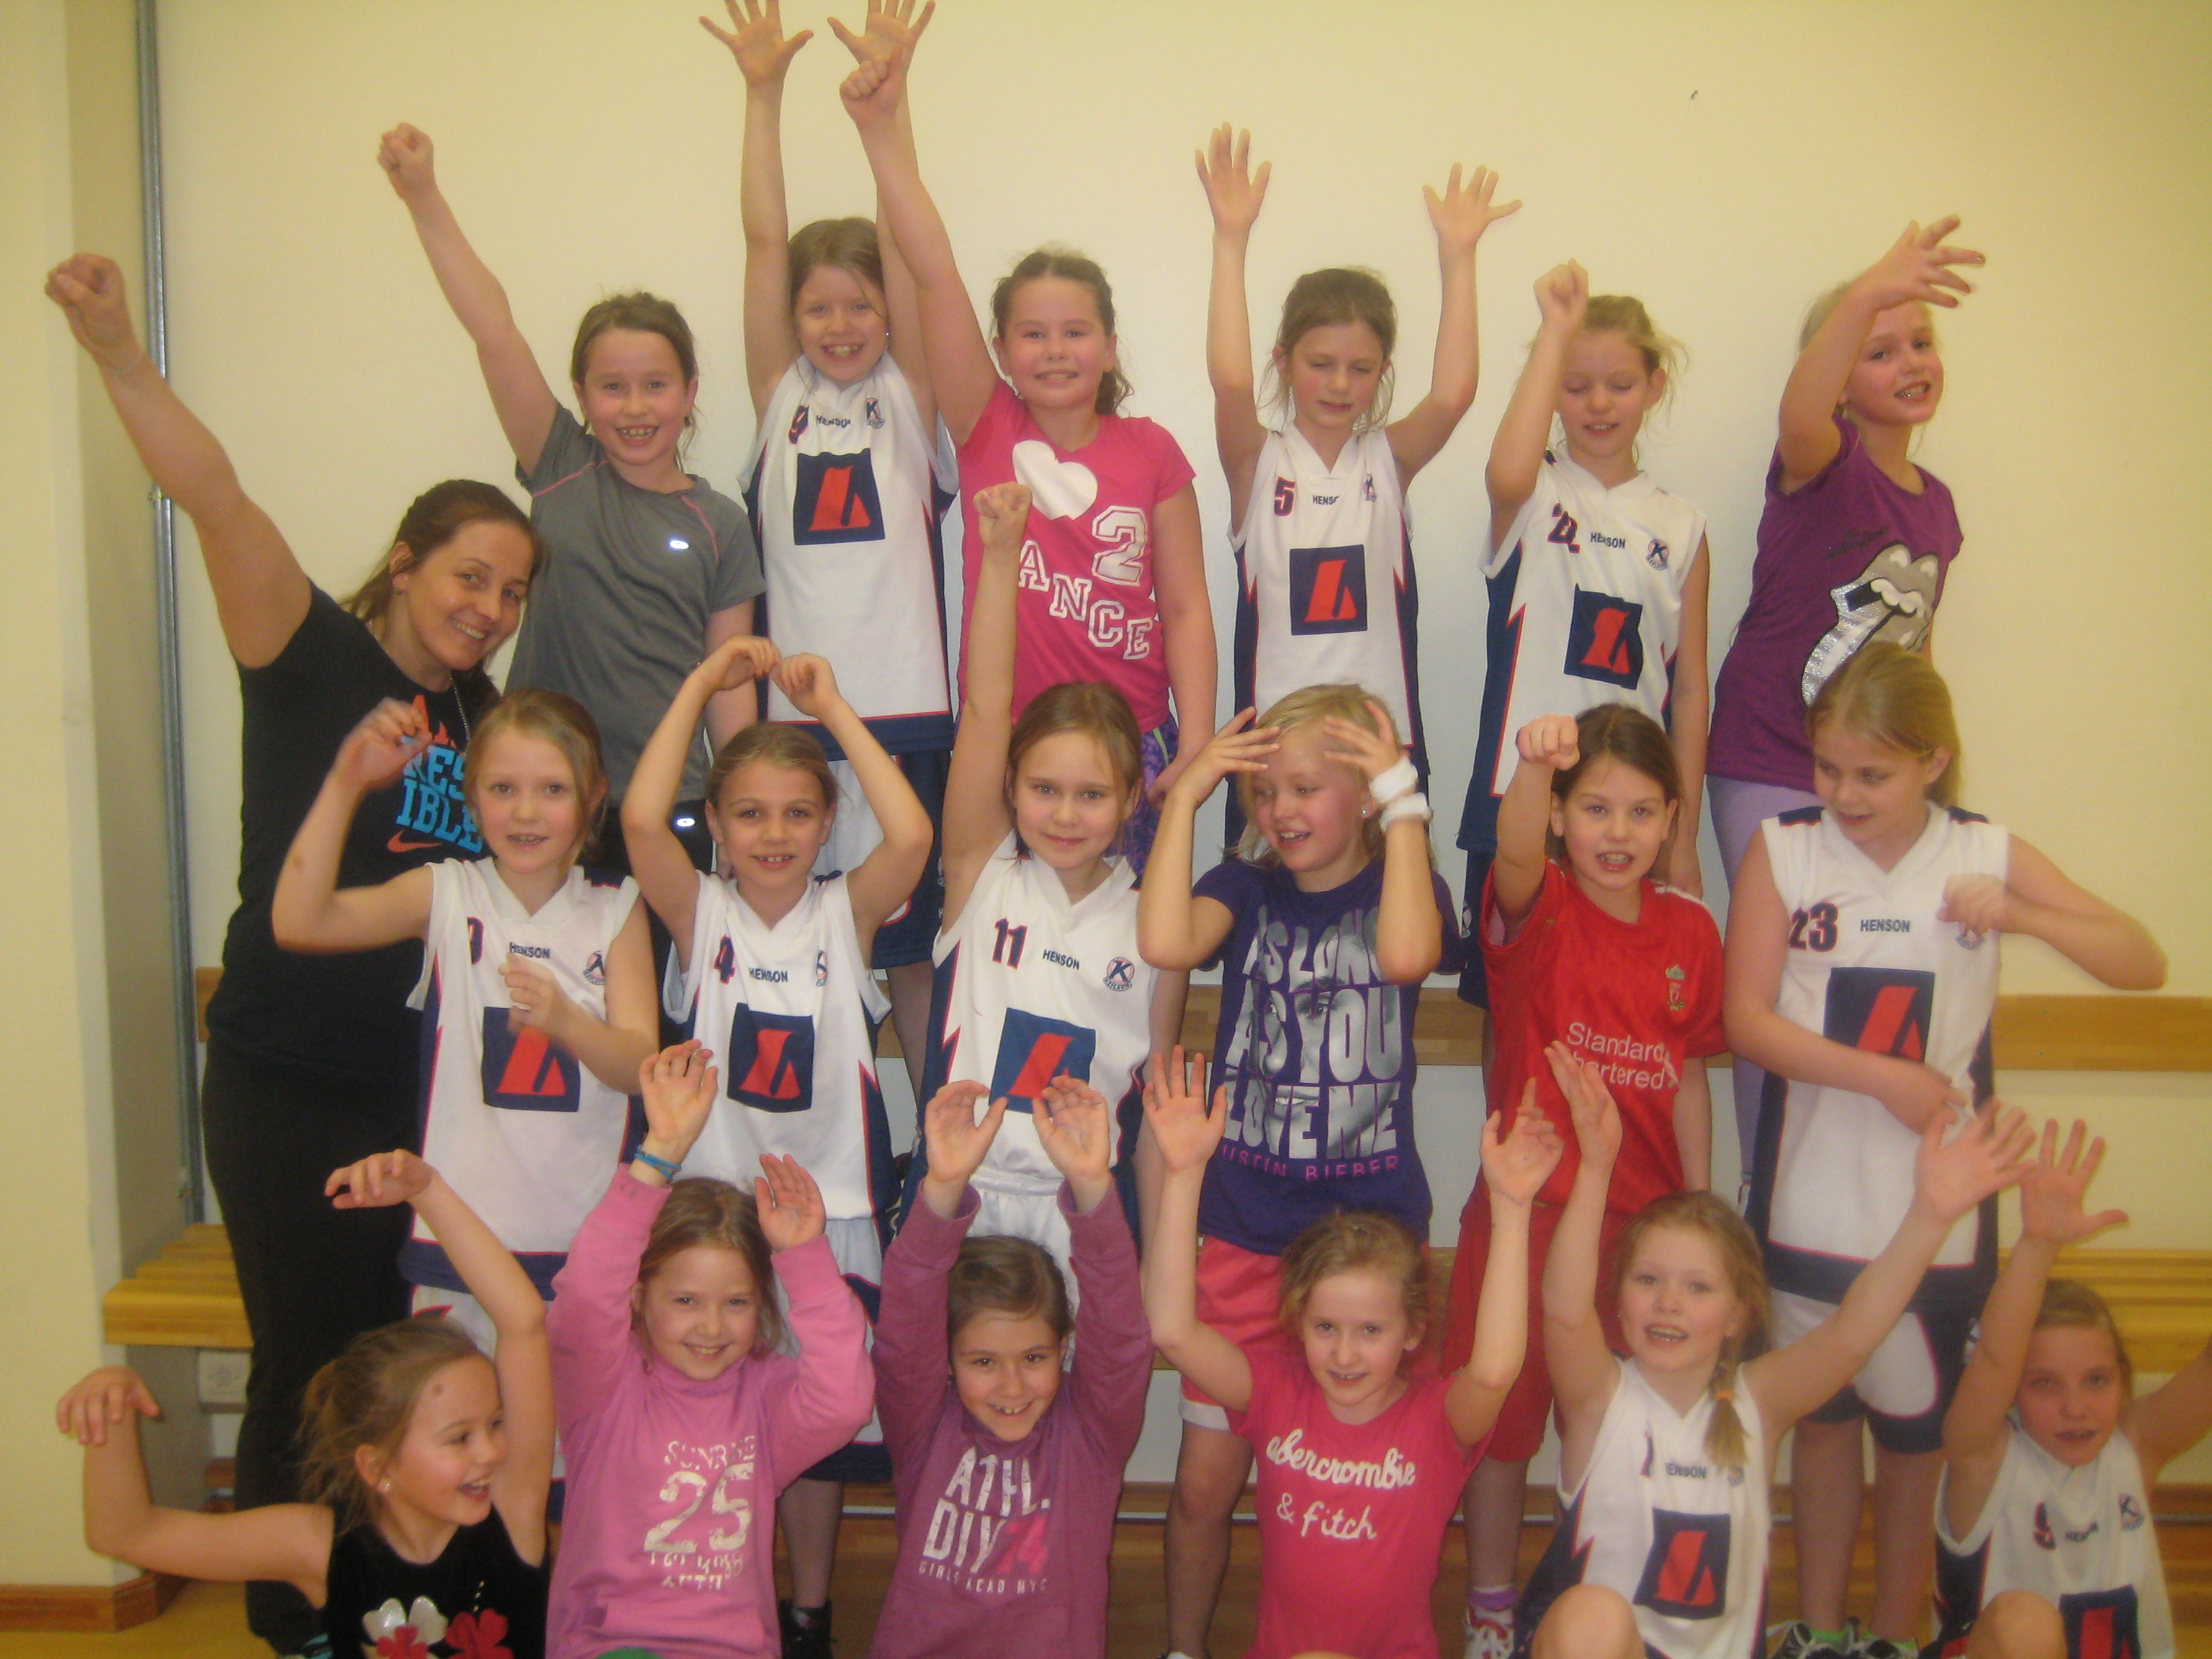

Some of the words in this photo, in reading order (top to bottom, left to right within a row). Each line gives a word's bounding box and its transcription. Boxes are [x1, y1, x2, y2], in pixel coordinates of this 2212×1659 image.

[1274, 476, 1295, 517] 5
[1313, 495, 1339, 505] HENS
[1092, 505, 1148, 587] 2
[1018, 540, 1153, 660] ANCE
[992, 918, 1028, 969] 11
[1242, 905, 1289, 984] AS
[1788, 902, 1839, 952] 23
[1860, 919, 1910, 932] HENSON
[714, 934, 735, 984] 4
[749, 967, 788, 983] HENSON
[1042, 949, 1080, 970] HENSON
[1225, 978, 1288, 1078] AS
[1294, 983, 1403, 1084] YOU
[1567, 1022, 1665, 1062] Standard
[1223, 1069, 1320, 1159] LOVE
[1326, 1082, 1401, 1159] ME
[1222, 1144, 1287, 1177] USTIN
[1305, 1155, 1399, 1182] BIEBER
[1266, 1429, 1416, 1490] abercrombie
[644, 1462, 754, 1554] 25
[1277, 1493, 1294, 1524] &
[1301, 1501, 1377, 1540] fitch
